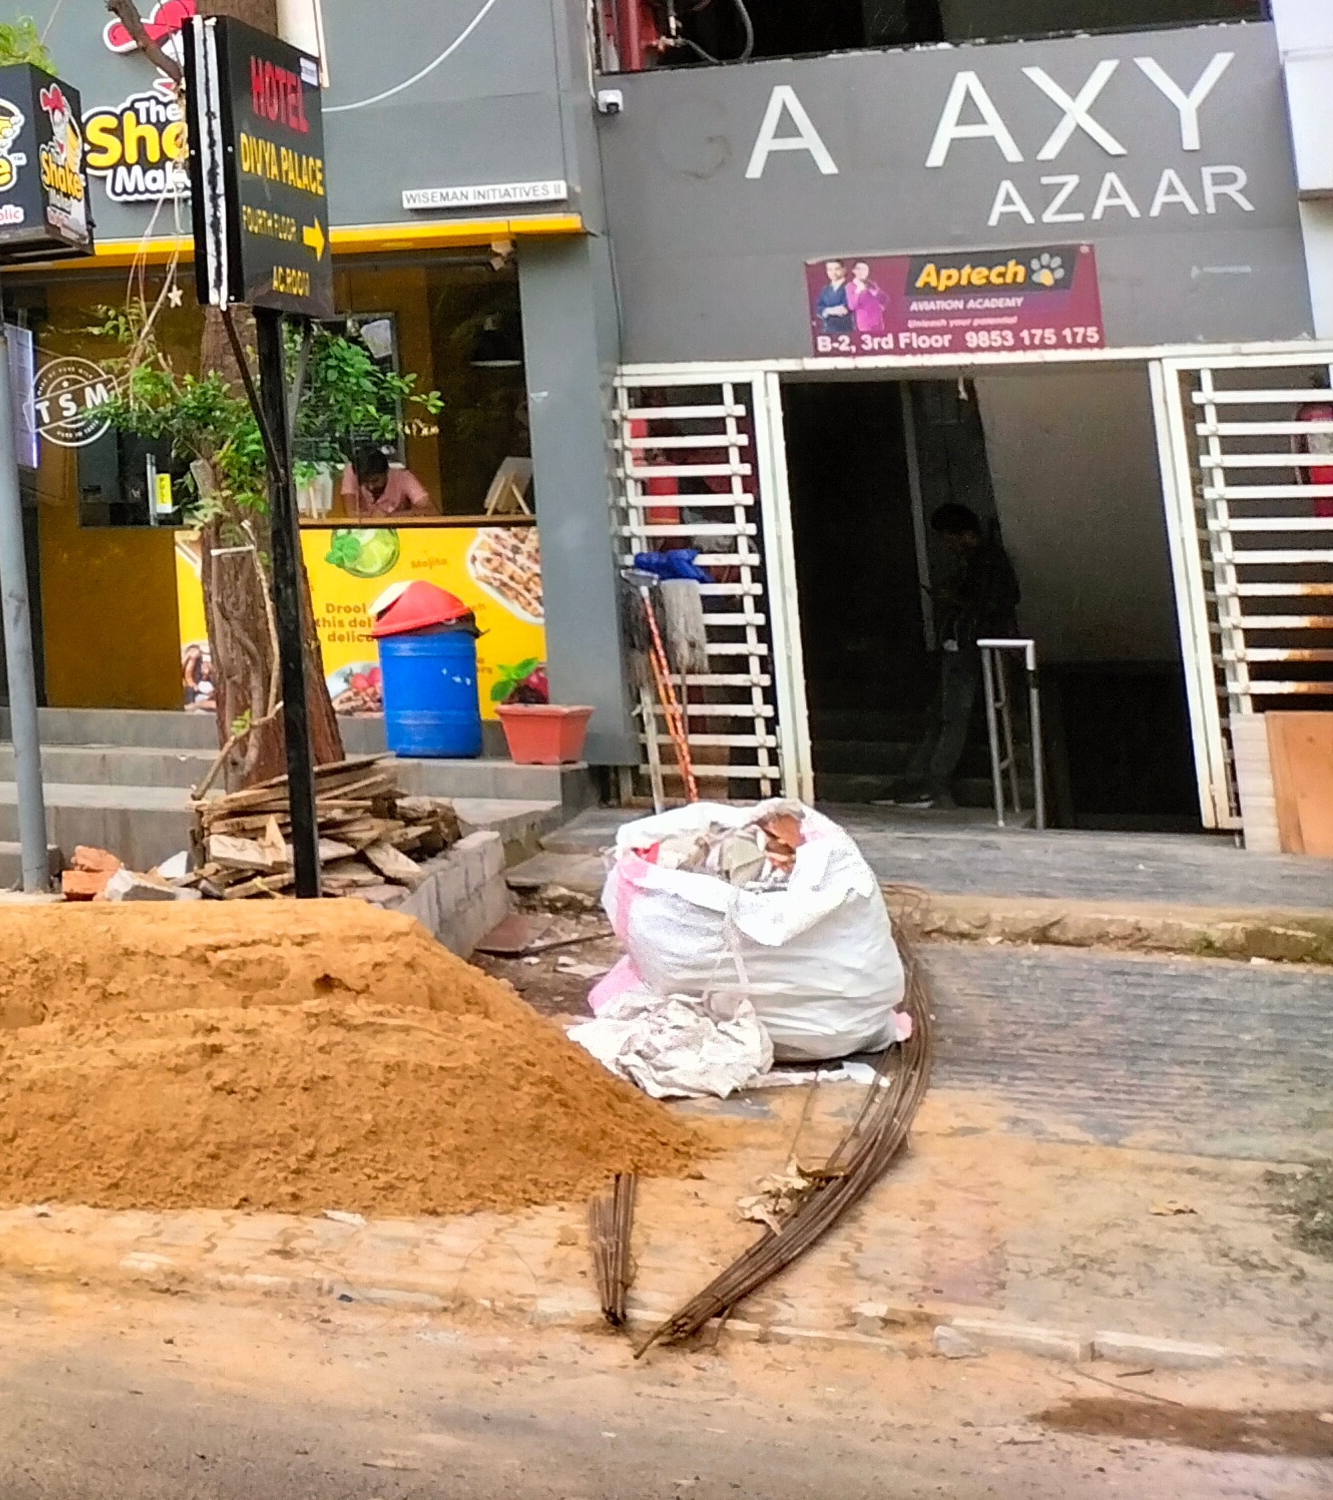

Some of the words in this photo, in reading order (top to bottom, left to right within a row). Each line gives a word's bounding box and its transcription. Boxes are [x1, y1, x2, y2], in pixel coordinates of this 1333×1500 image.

[249, 55, 310, 134] HOTEL
[134, 100, 183, 124] The
[40, 149, 83, 201] Shake
[239, 131, 280, 182] DIVYA
[280, 145, 325, 197] PALACE
[404, 189, 469, 205] WISEMAN
[472, 184, 550, 201] INITIATIVES
[986, 164, 1256, 227] AZAAR
[914, 259, 1026, 292] Aptech
[909, 299, 965, 312] AVIATION
[966, 296, 1024, 310] ACADEMY
[816, 334, 857, 354] B-2,
[860, 332, 894, 351] 3rd
[898, 331, 952, 349] Floor
[964, 329, 1015, 349] 9853
[1020, 327, 1058, 346] 175
[1061, 326, 1100, 345] 175
[325, 602, 367, 615] Drool
